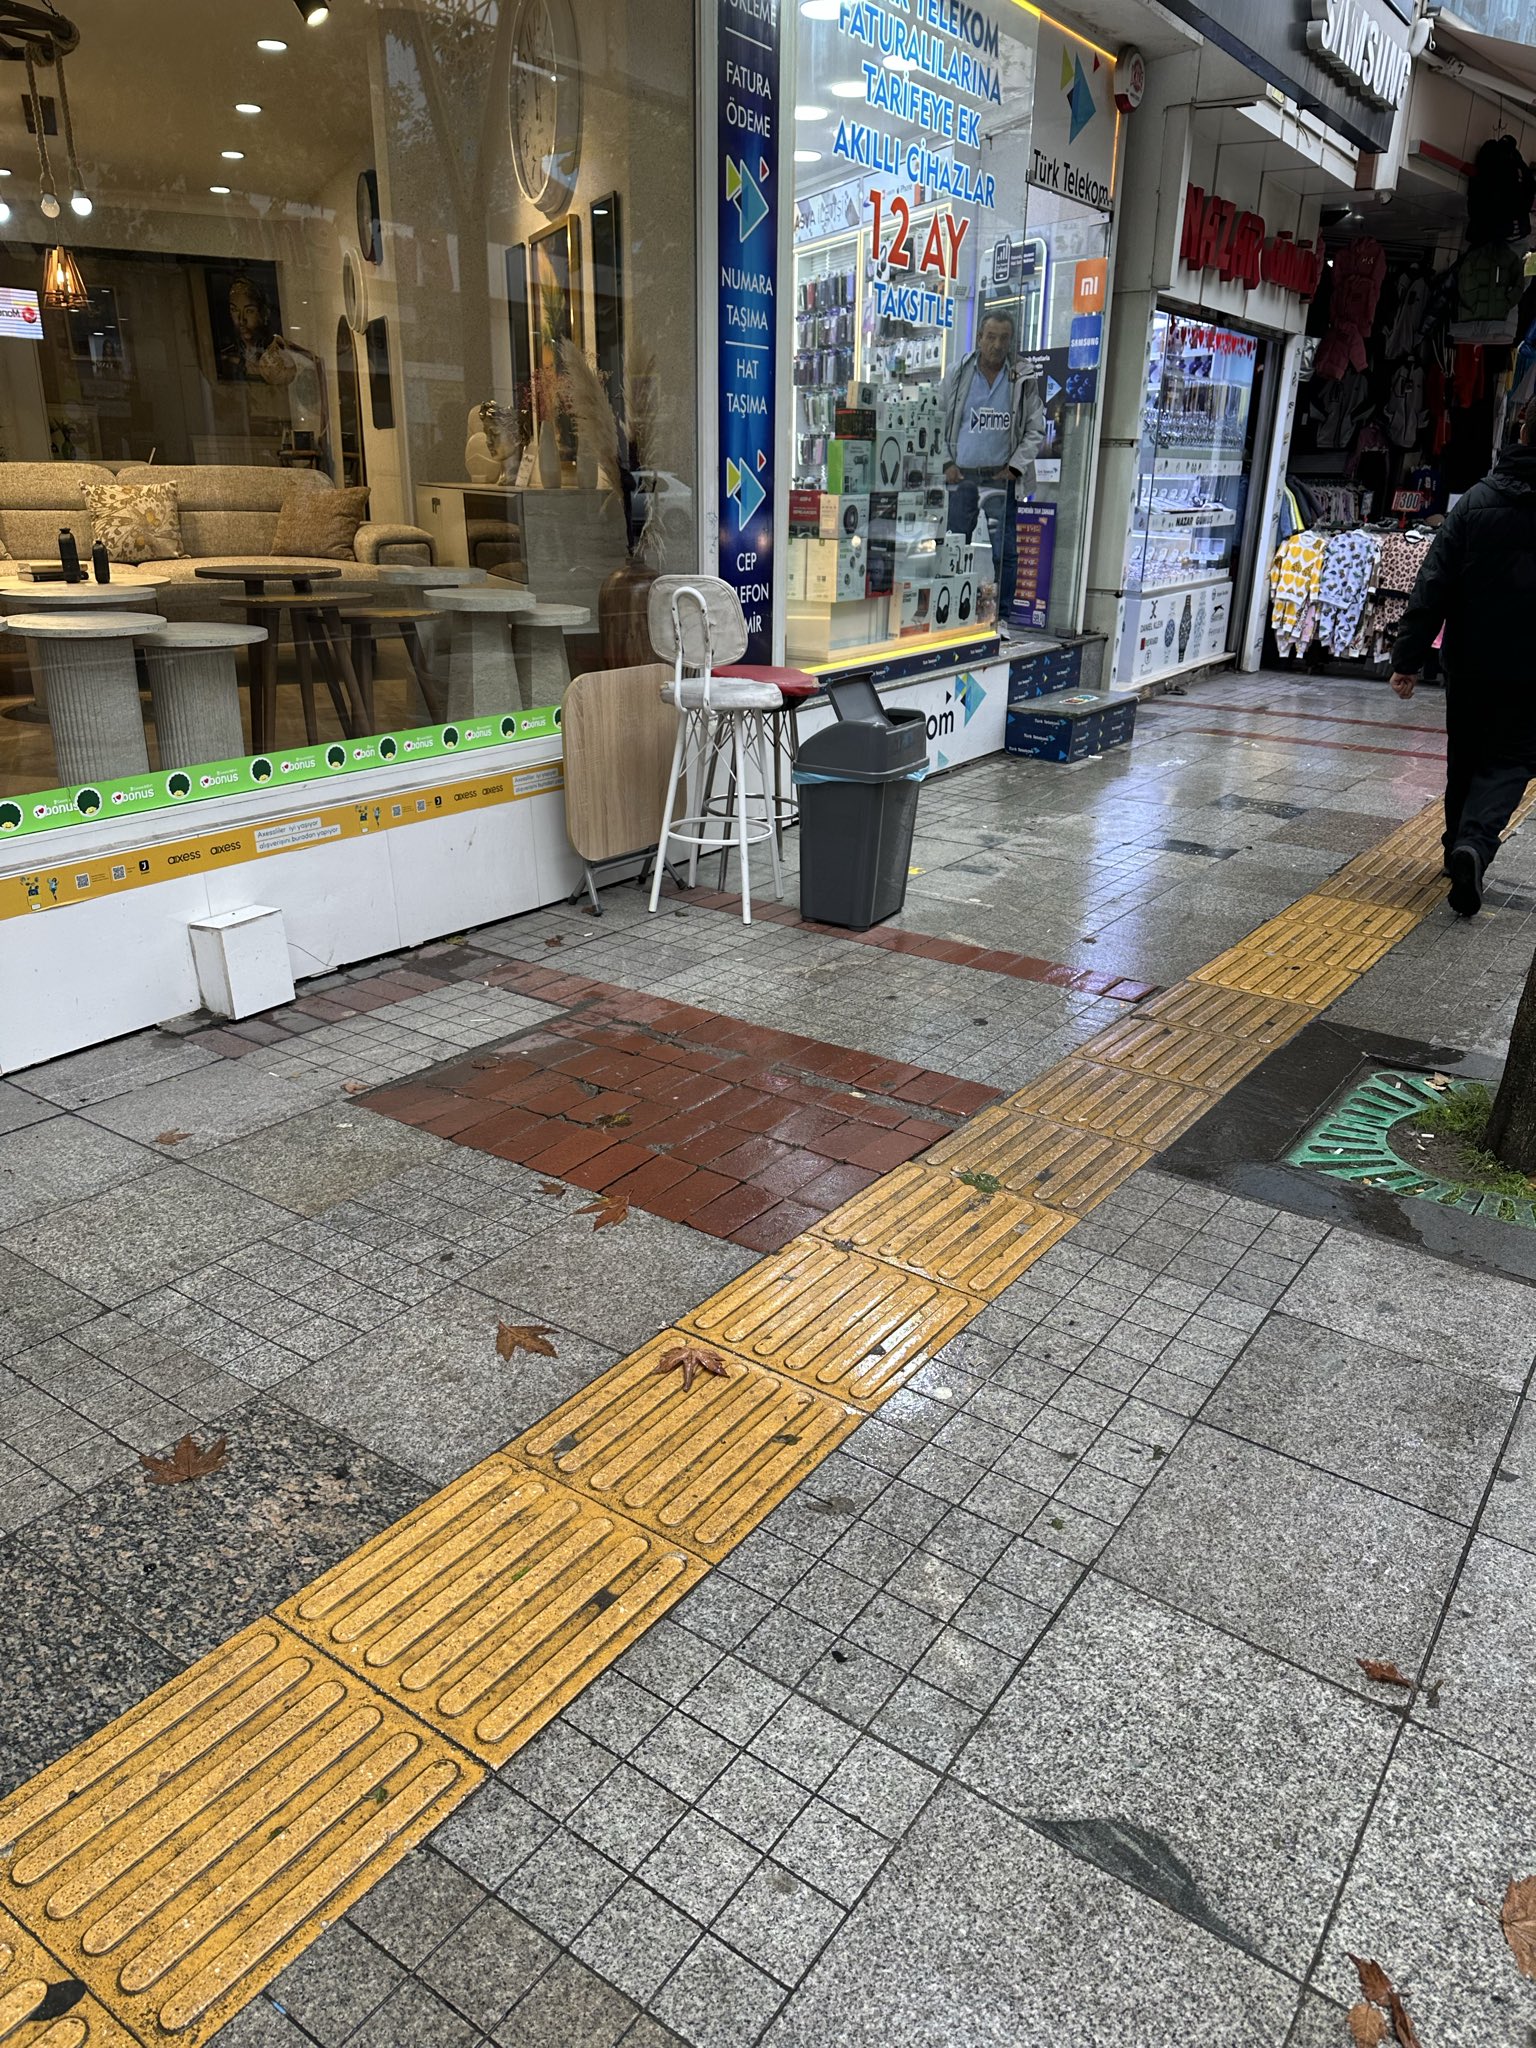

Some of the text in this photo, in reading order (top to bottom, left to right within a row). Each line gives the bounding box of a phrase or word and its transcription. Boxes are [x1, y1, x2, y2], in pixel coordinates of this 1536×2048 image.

[723, 0, 777, 28] KLEME
[838, 2, 1002, 106] FATURALILARINA
[1319, 0, 1412, 111] SAMSUNG
[726, 59, 772, 101] FATURA
[726, 96, 771, 138] ÖDEME
[861, 60, 982, 151] TARİFEYE EK
[832, 115, 996, 210] AKILLI CİHAZLAR
[1033, 148, 1110, 206] Türk Telekom
[918, 206, 972, 281] AY
[1180, 181, 1266, 291] NAZAR
[722, 266, 774, 296] NUMARA
[726, 304, 769, 333] TAŞIMA
[873, 281, 955, 330] TAKSİTLE
[1070, 336, 1100, 348] SAMSUNG
[736, 358, 760, 380] HAT
[726, 393, 768, 419] TAŞIMA
[979, 411, 1011, 432] prime
[1399, 492, 1420, 509] 300
[736, 552, 757, 572] CEP
[733, 582, 769, 604] EFON
[744, 611, 763, 634] MİR
[209, 771, 239, 785] bonus
[288, 759, 316, 771] bonus
[120, 788, 155, 802] bonus
[44, 801, 80, 816] bonus
[167, 849, 202, 865] axess
[210, 840, 242, 856] axess
